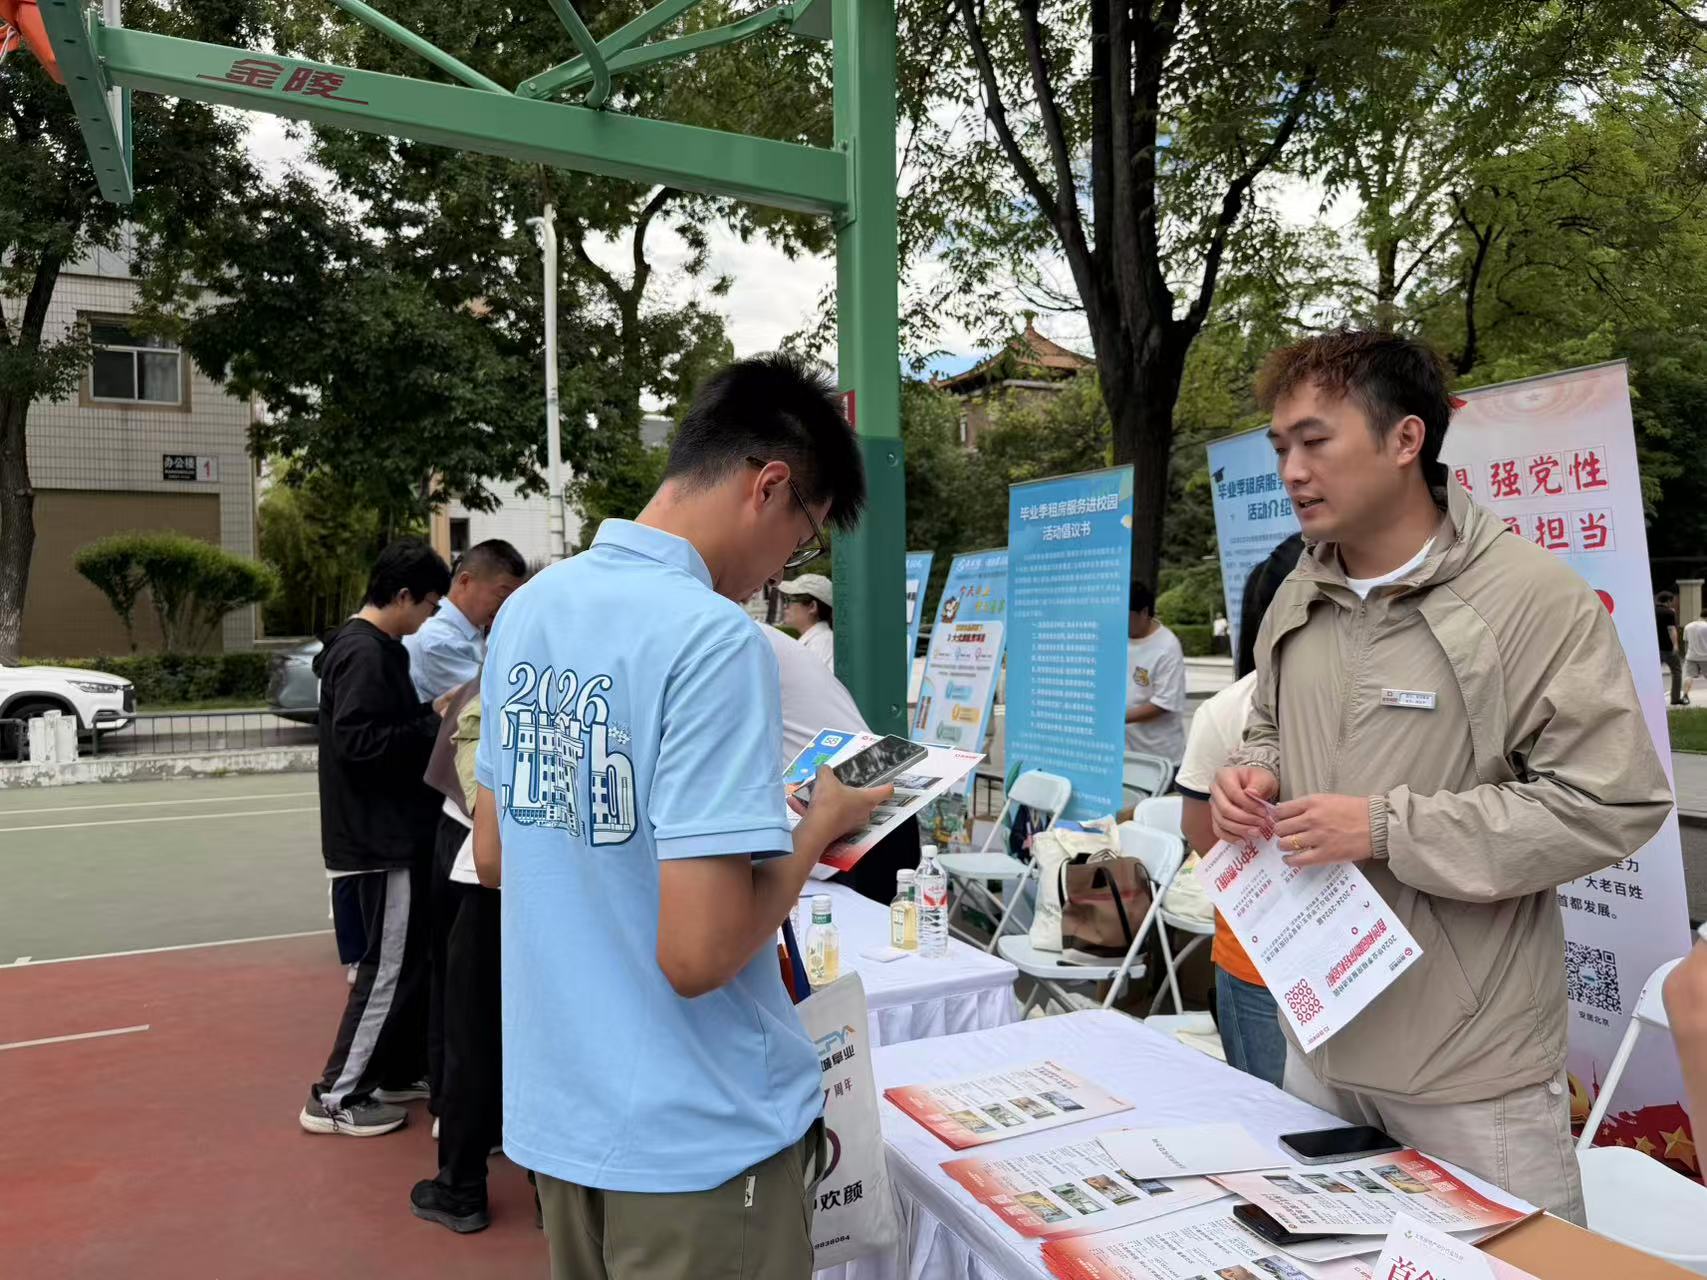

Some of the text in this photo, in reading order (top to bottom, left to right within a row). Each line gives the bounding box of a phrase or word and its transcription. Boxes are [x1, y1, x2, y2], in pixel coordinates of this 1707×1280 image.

[197, 58, 369, 106] 金陵
[203, 460, 212, 480] 1
[1489, 451, 1607, 498] 强党性
[1020, 493, 1119, 521] 毕业季租房服务进校园
[1247, 496, 1292, 521] 活动介绍
[1042, 520, 1092, 541] 活动倡议书
[507, 660, 614, 734] 2026
[1571, 875, 1644, 900] 大老百姓
[814, 1180, 863, 1212] 欢颜
